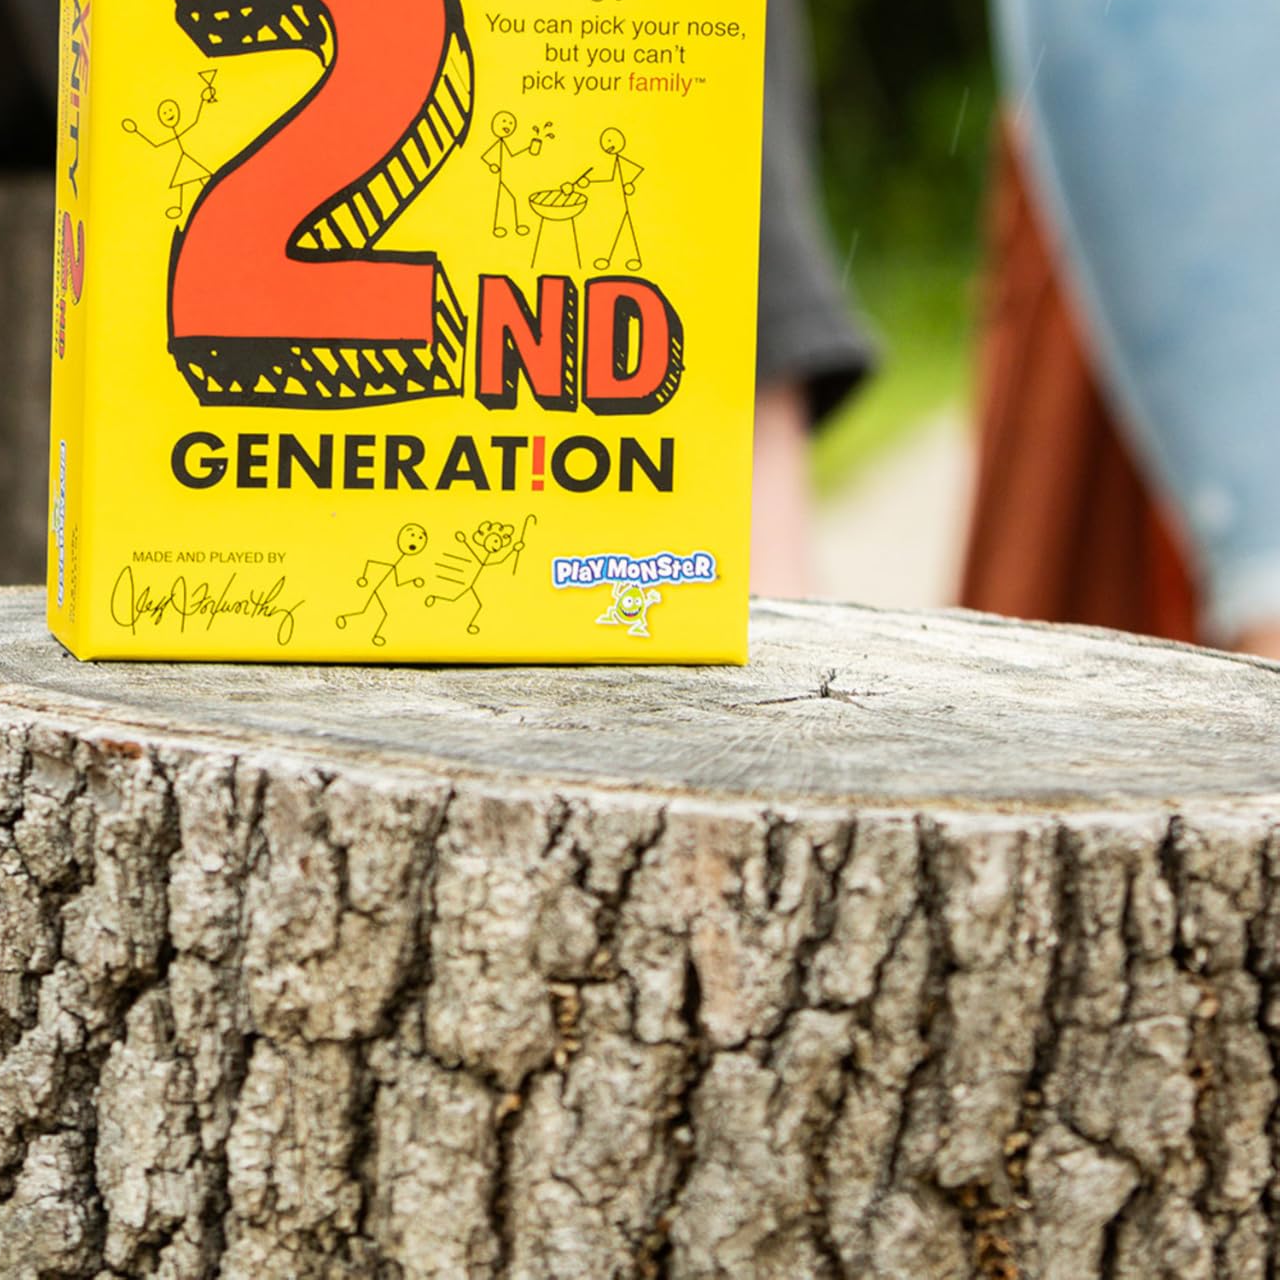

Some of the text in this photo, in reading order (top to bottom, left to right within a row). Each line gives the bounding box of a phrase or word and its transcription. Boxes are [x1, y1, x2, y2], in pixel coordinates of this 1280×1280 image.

[485, 13, 746, 40] You can pick your nose,
[545, 42, 686, 68] but you can’t
[521, 70, 566, 95] pick
[573, 75, 622, 96] your
[132, 551, 286, 564] MADE AND PLAYED BY
